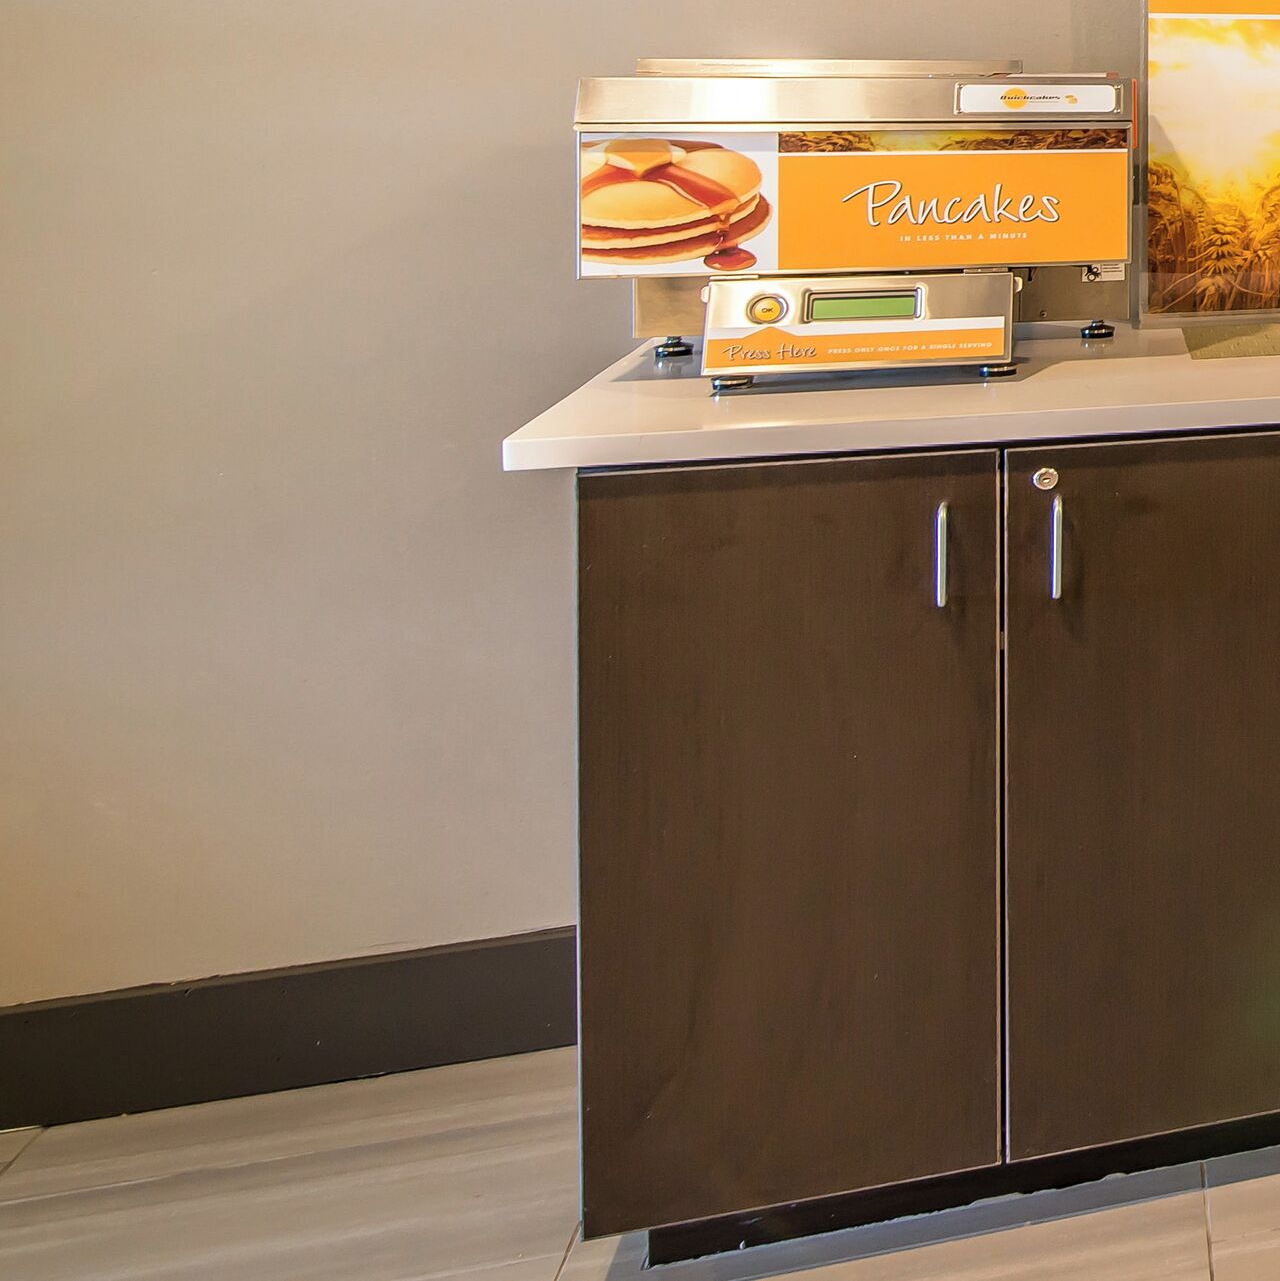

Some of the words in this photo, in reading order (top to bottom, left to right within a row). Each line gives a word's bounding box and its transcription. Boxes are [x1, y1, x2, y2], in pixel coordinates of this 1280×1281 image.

[841, 179, 1061, 227] Pancakes
[989, 232, 1027, 240] MINUTE
[721, 344, 771, 361] Press
[776, 343, 817, 361] Here
